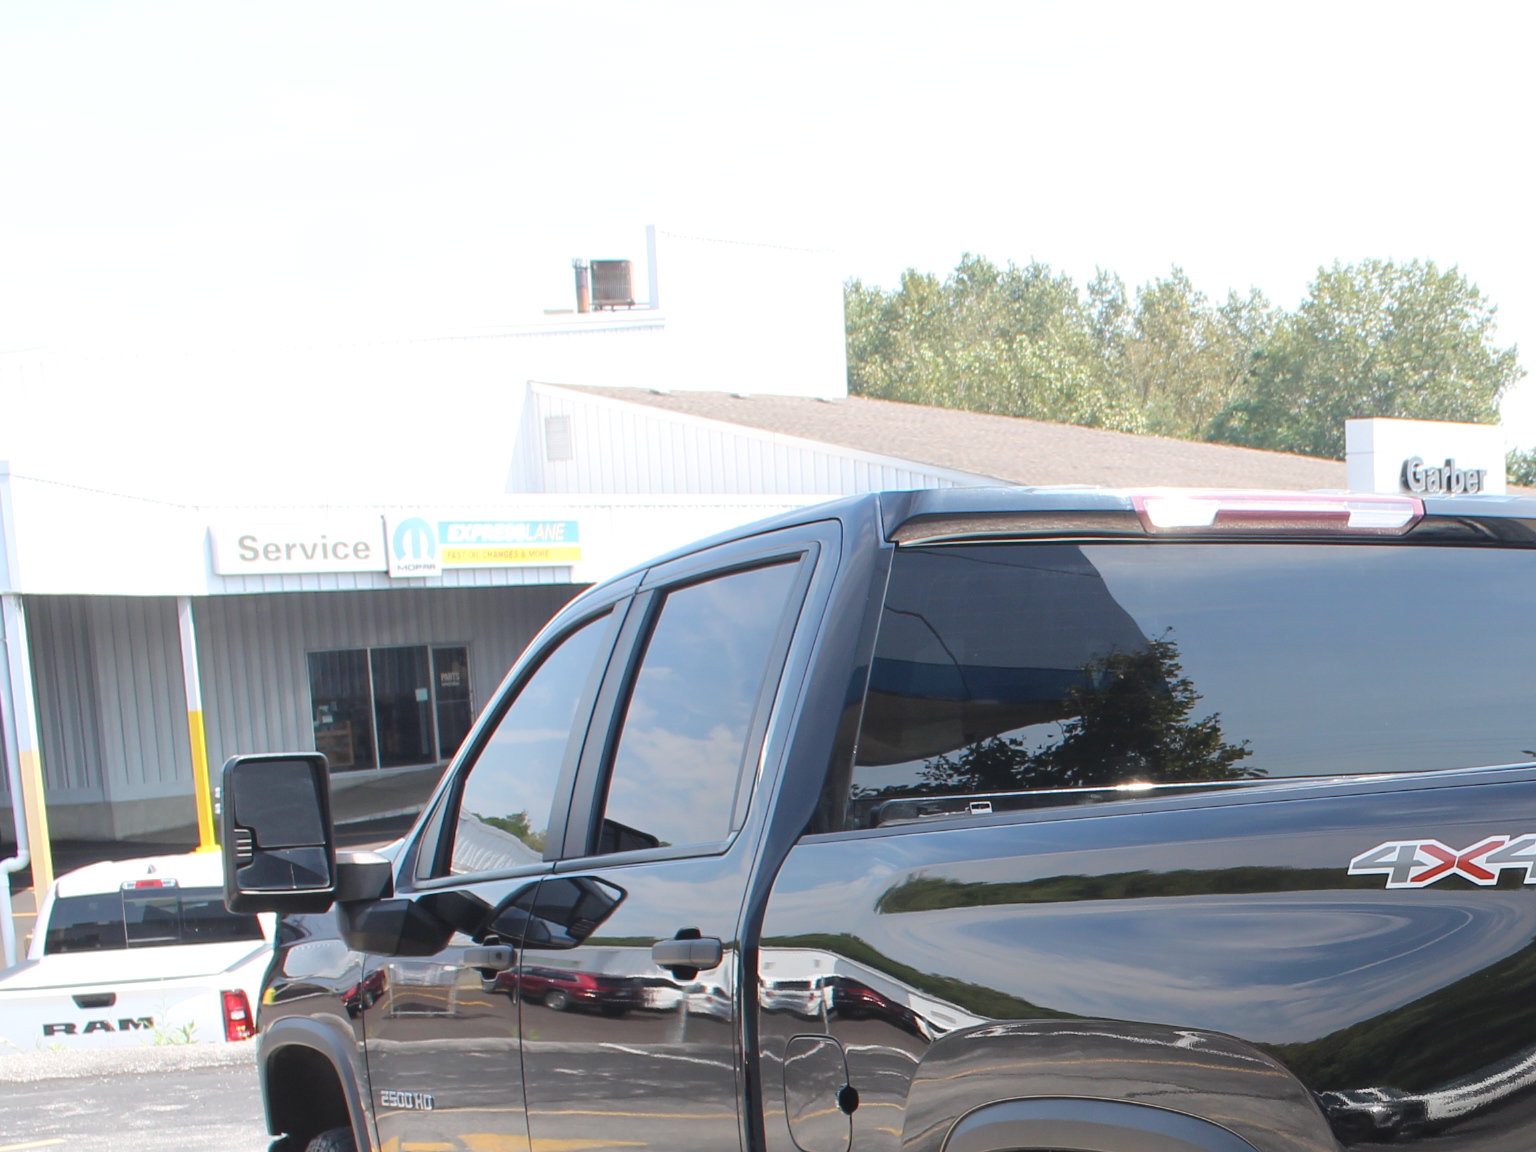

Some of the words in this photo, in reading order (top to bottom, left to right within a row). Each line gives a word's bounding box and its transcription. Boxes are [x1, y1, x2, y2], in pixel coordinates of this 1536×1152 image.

[1400, 456, 1488, 494] Garber
[238, 534, 371, 562] Service
[482, 550, 519, 559] CHANGES
[528, 549, 550, 558] MORE
[396, 563, 437, 572] MOPAR
[42, 1016, 155, 1037] RAM
[380, 1090, 413, 1109] 2500
[414, 1092, 433, 1111] HD
